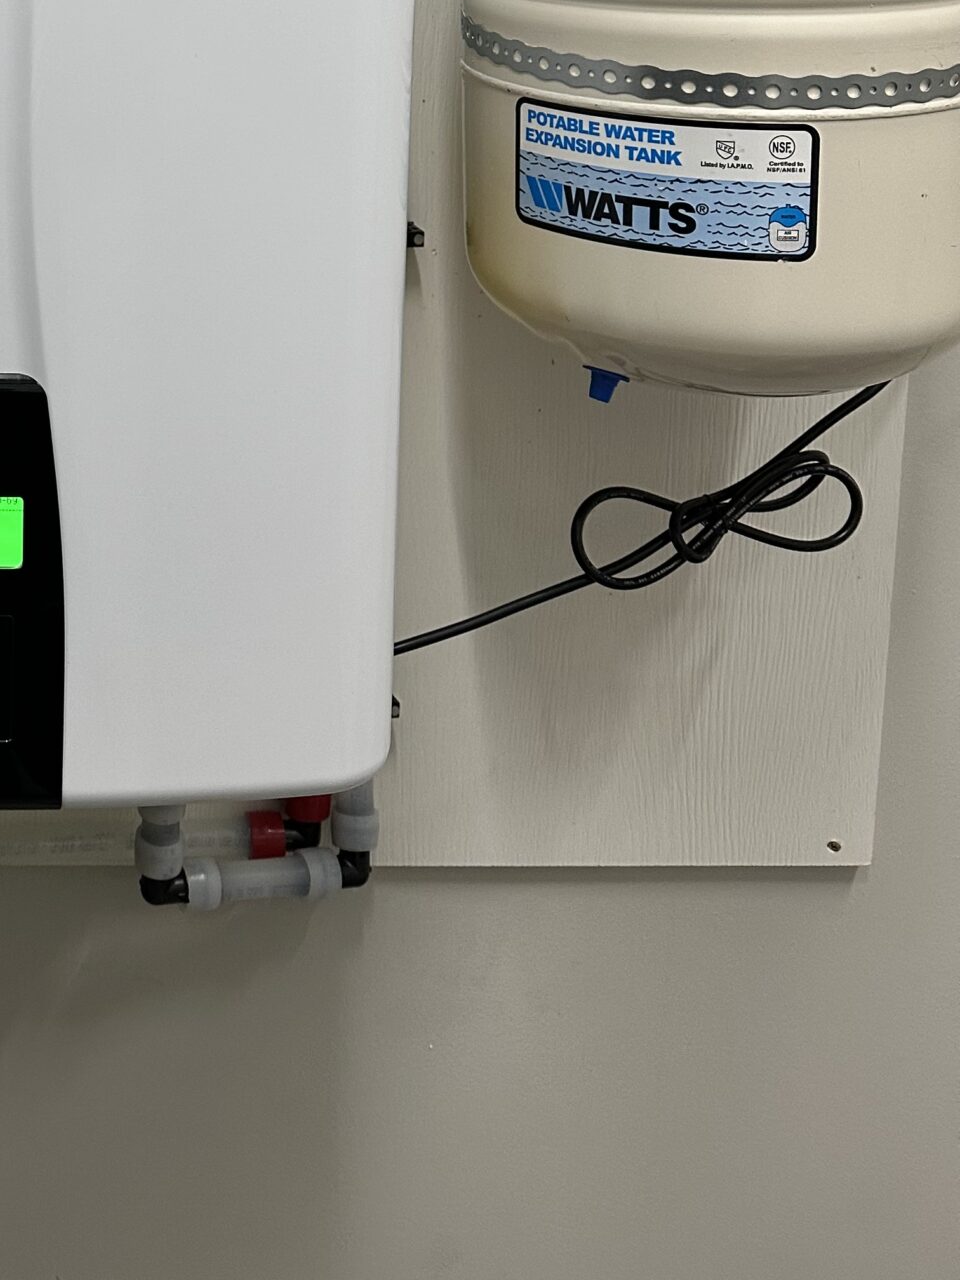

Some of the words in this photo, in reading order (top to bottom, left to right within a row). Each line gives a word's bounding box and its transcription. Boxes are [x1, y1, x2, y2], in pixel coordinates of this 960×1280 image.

[527, 109, 600, 137] POTABLE
[604, 123, 675, 146] WATER
[525, 127, 620, 159] EXPANSION
[624, 145, 682, 167] TANK
[700, 160, 718, 169] Listed
[719, 162, 726, 170] by
